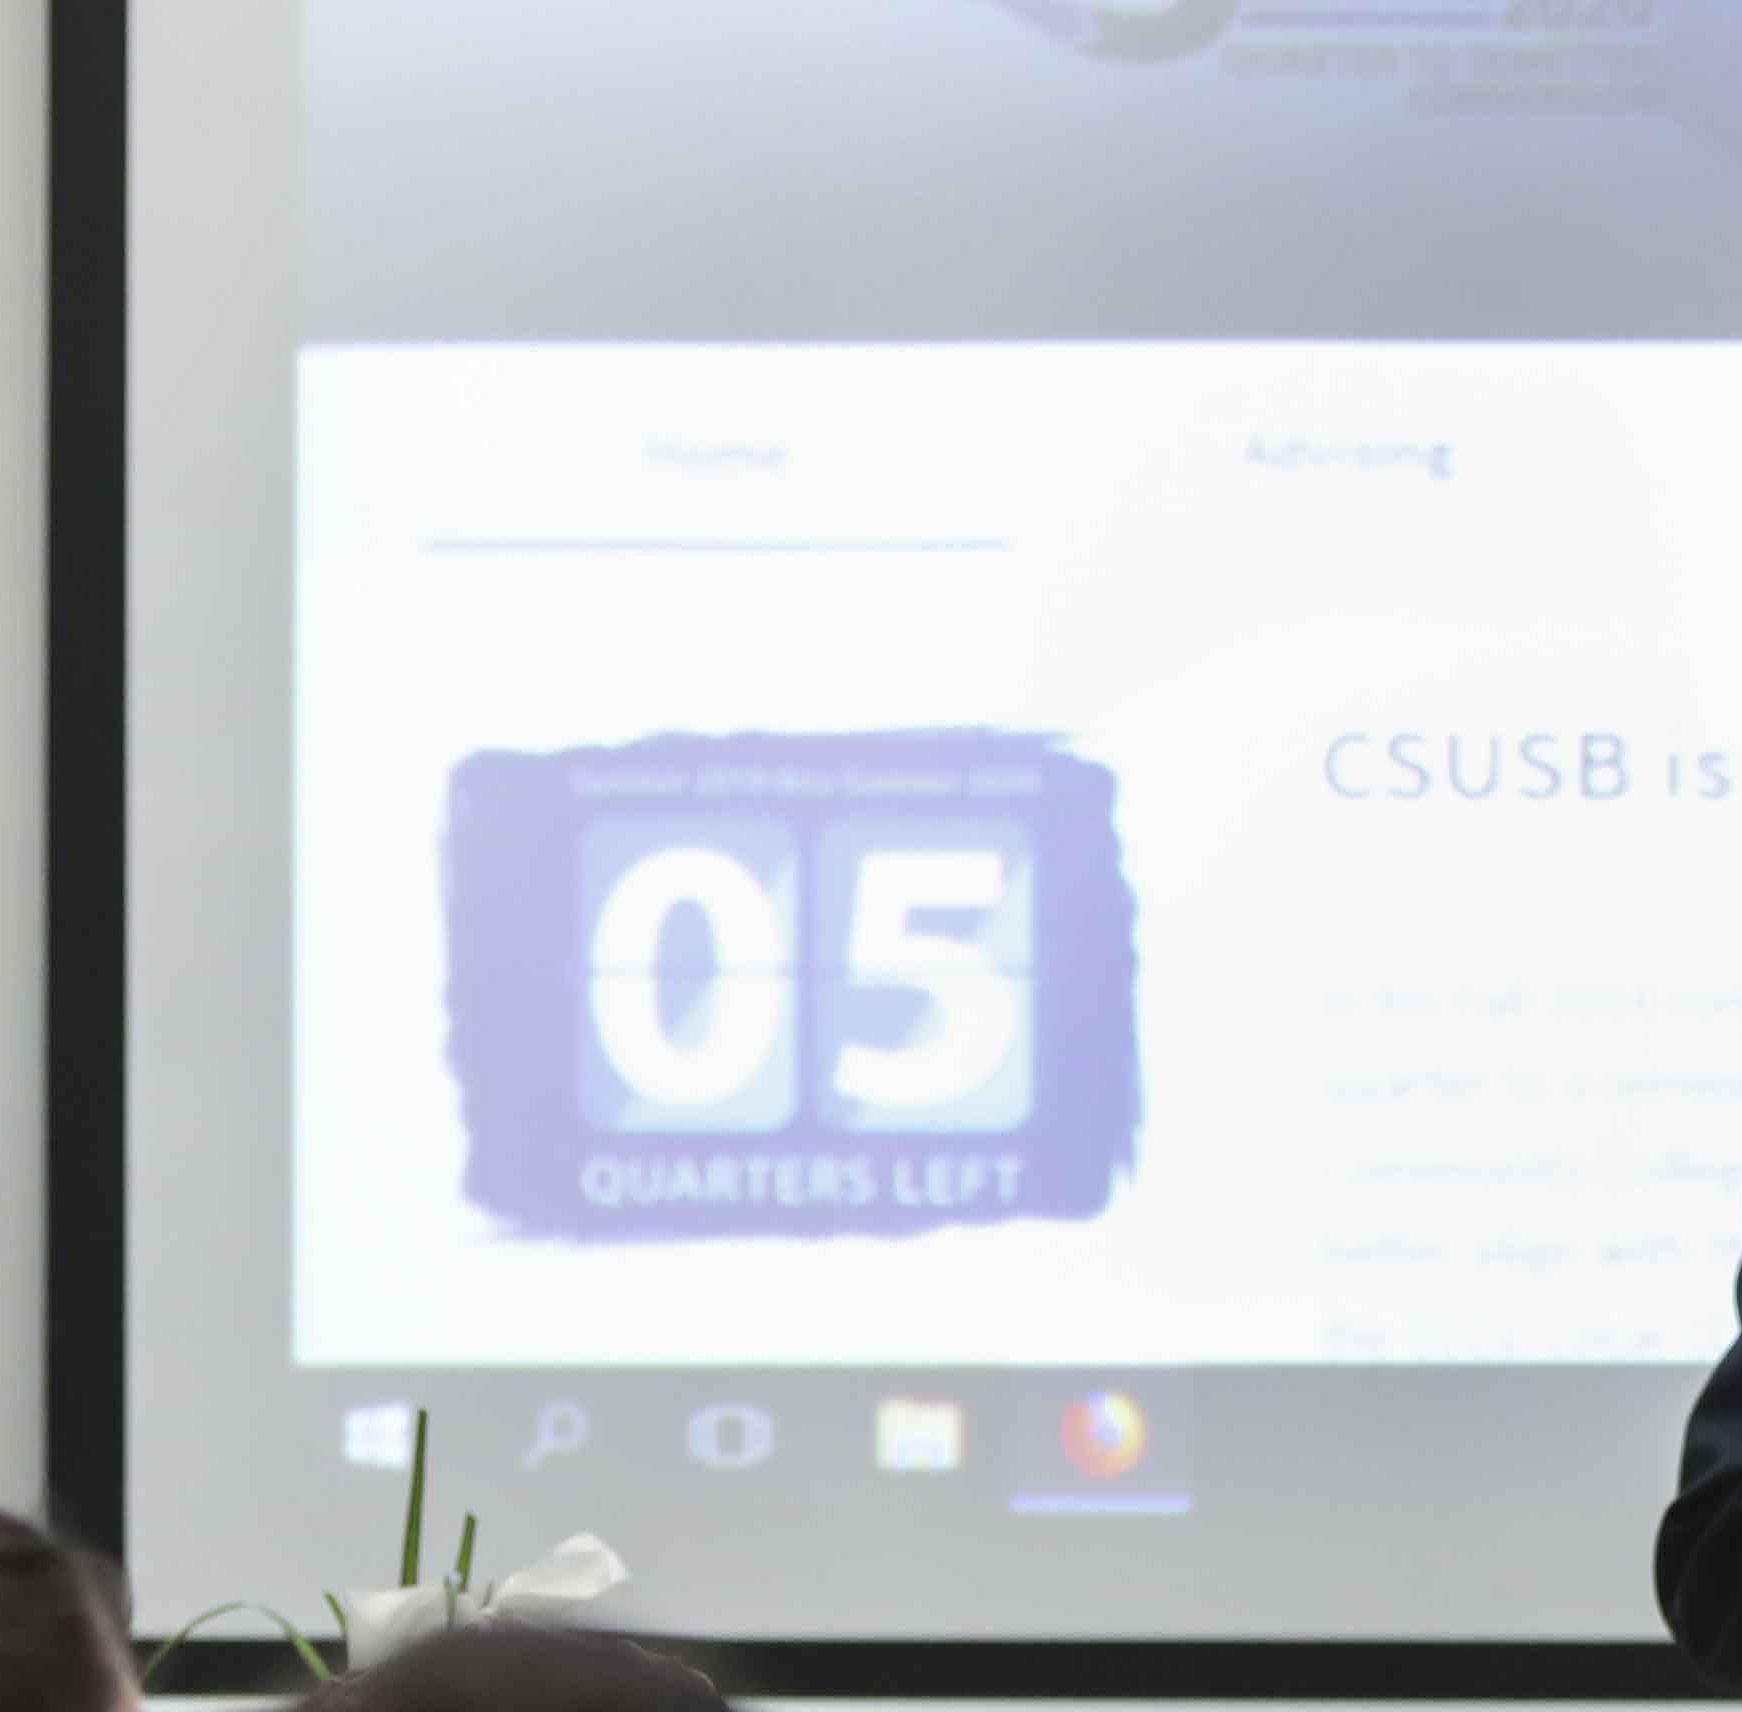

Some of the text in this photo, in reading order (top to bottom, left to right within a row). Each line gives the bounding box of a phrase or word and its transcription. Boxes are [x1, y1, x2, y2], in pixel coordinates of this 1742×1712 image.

[1243, 432, 1457, 482] Advising
[1323, 731, 1631, 802] CSUSB
[1665, 731, 1735, 802] is
[594, 848, 1018, 1108] 05
[580, 1155, 1022, 1207] QUARTERS LEFT
